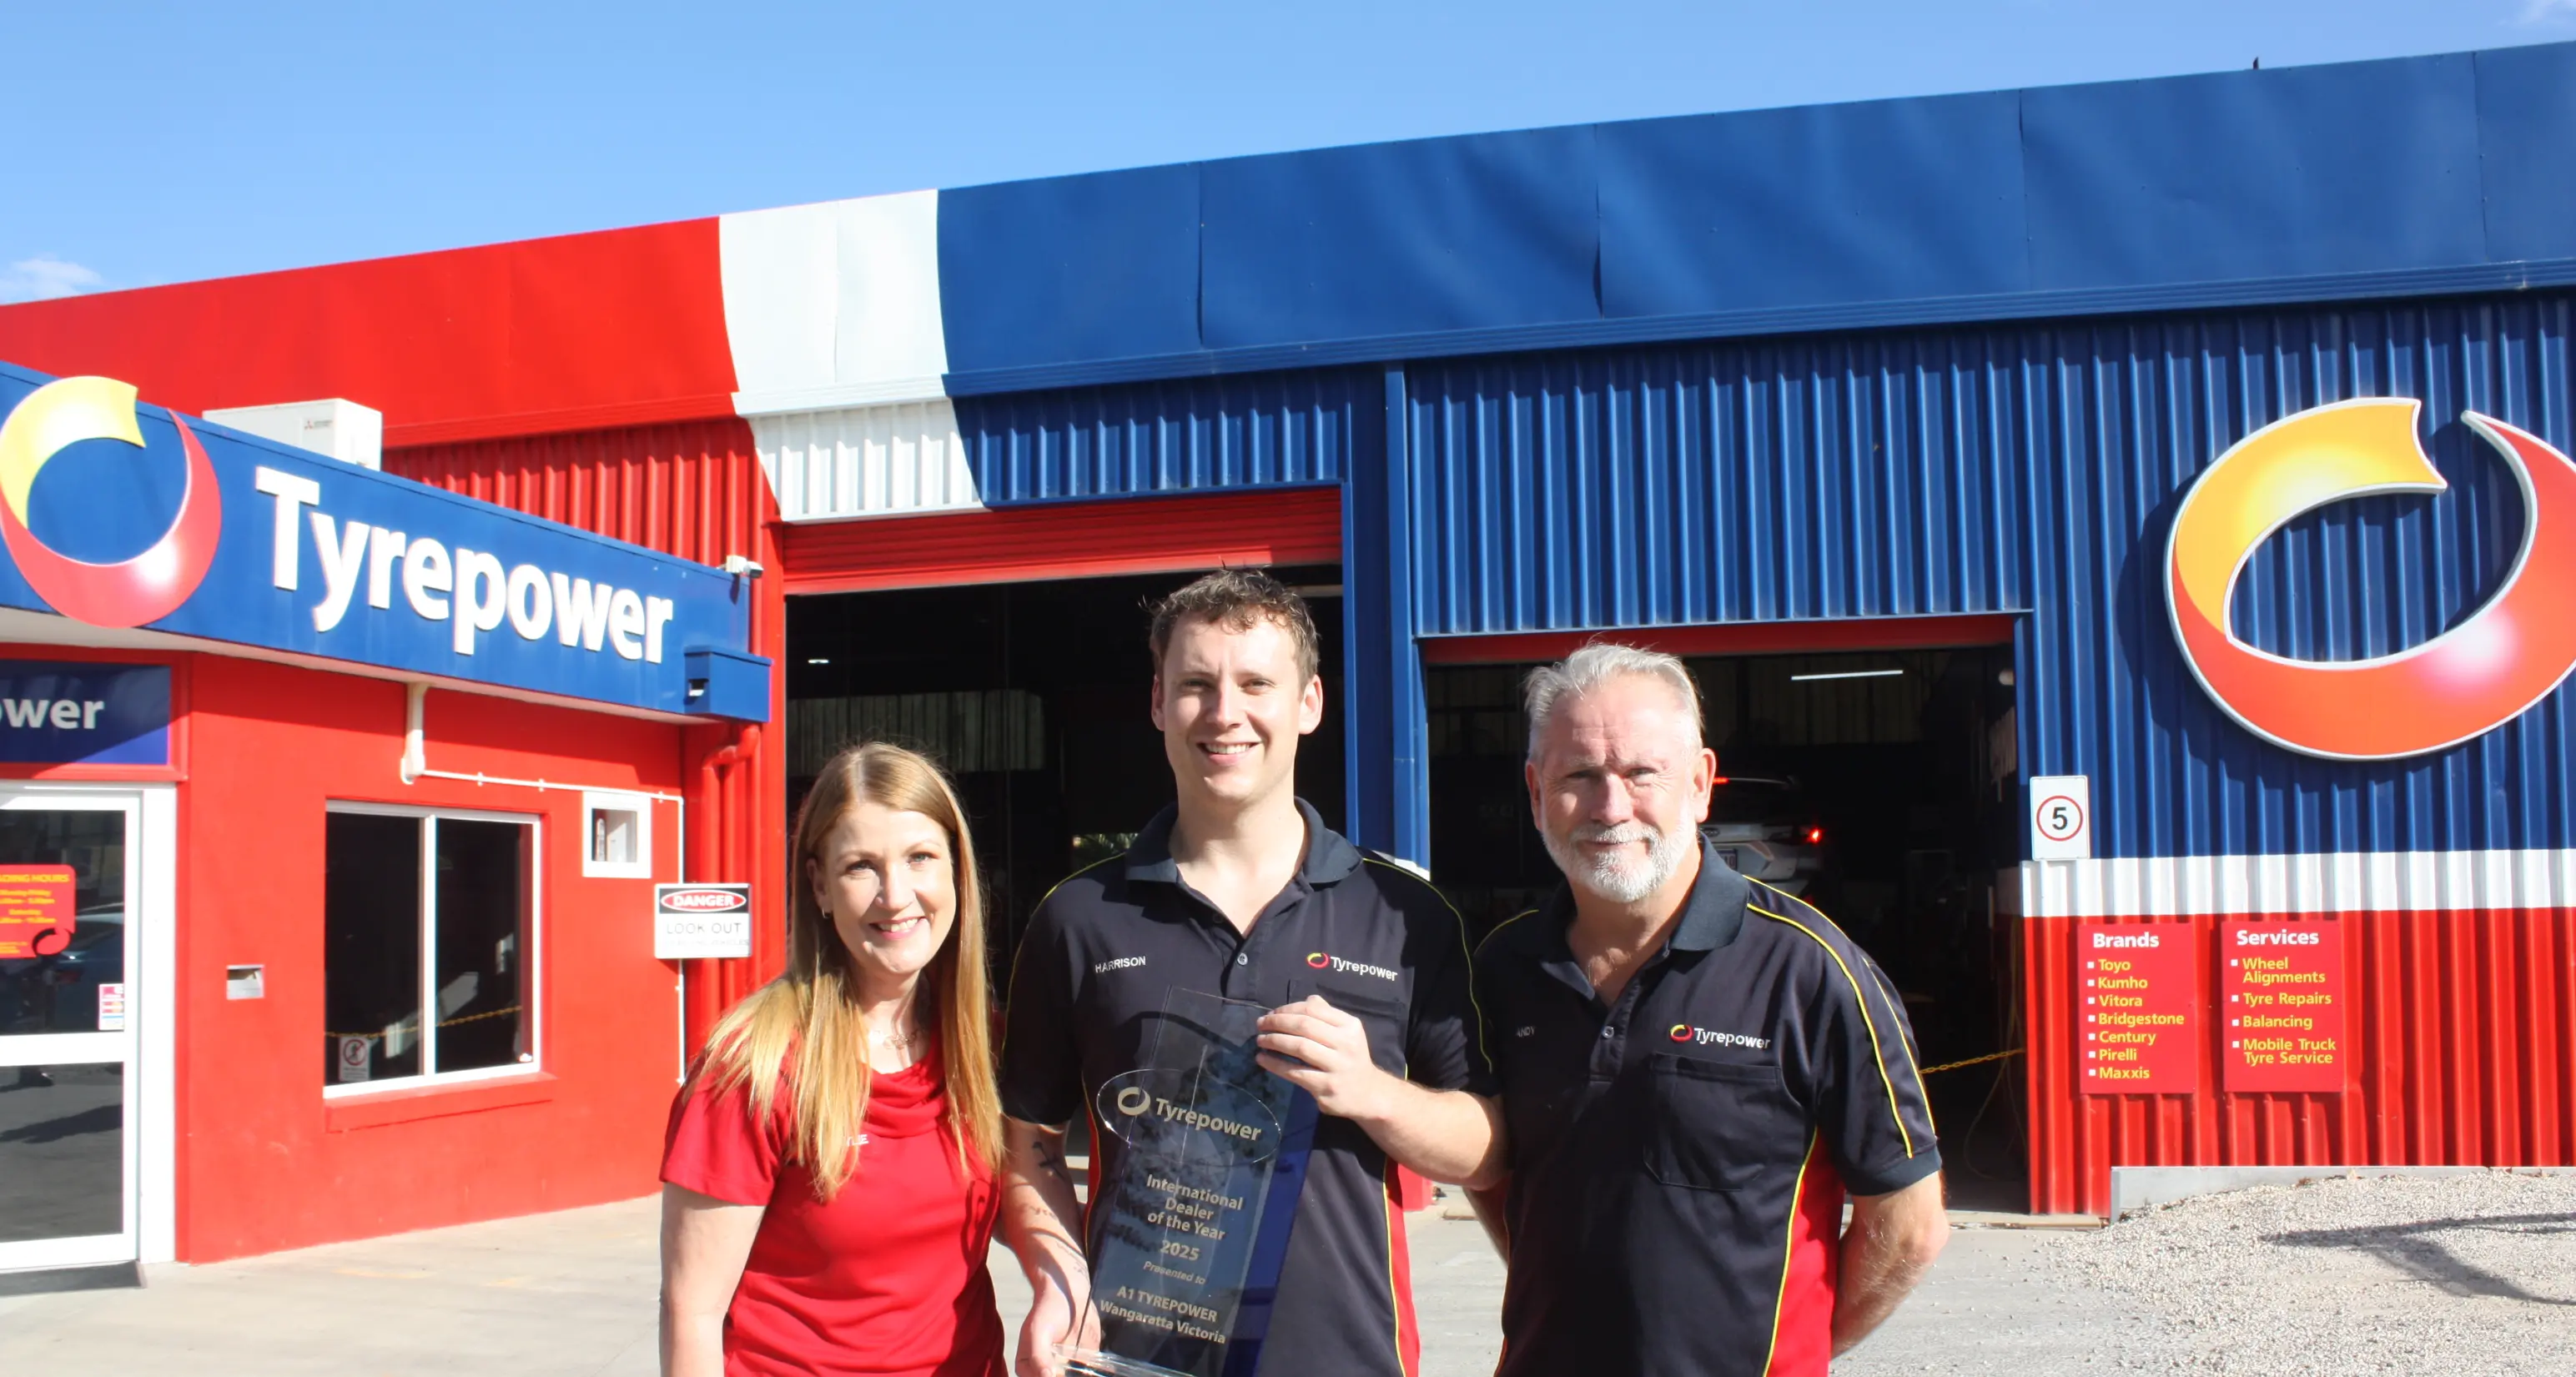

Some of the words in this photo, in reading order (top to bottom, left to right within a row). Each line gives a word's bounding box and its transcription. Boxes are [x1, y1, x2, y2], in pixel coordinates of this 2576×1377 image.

[255, 465, 673, 664] Tyrepower
[0, 699, 104, 729] wer
[2052, 807, 2068, 831] 5
[673, 895, 734, 907] DANGER
[667, 922, 706, 934] LOOK
[712, 922, 742, 934] OUT
[2093, 932, 2160, 948] Brands
[2236, 929, 2320, 946] Services
[1094, 955, 1146, 973] HARRISON
[1331, 956, 1398, 982] Tyrepower
[2098, 959, 2131, 974] Toyo
[2242, 957, 2289, 970] Wheel
[2098, 976, 2148, 989] Kumho
[2242, 971, 2326, 984] Alignments
[2099, 994, 2143, 1007] Vitora
[2243, 993, 2273, 1008] Tyre
[2278, 993, 2332, 1007] Repairs
[2098, 1012, 2185, 1028] Bridgestone
[2242, 1015, 2313, 1031] Balancing
[1516, 1026, 1536, 1038] ANDY
[1694, 1028, 1771, 1050] Tyrepower
[2099, 1030, 2156, 1046] Century
[2243, 1038, 2293, 1051] Mobile
[2297, 1038, 2337, 1051] Truck
[2099, 1048, 2137, 1061] Pirelli
[2244, 1052, 2275, 1067] Tyre
[2280, 1051, 2333, 1064] Service
[2099, 1067, 2151, 1079] Maxxis
[1155, 1098, 1262, 1141] Tyrepower
[1146, 1174, 1244, 1210] International
[1165, 1198, 1215, 1220] Dealer
[1147, 1212, 1165, 1224] of
[1166, 1214, 1190, 1231] the
[1194, 1221, 1226, 1240] Year
[1160, 1239, 1200, 1260] 2025
[1143, 1260, 1195, 1281] Presented
[1195, 1274, 1205, 1284] to
[1116, 1285, 1135, 1300] A1
[1137, 1290, 1218, 1323] TYREPOWER
[1099, 1299, 1174, 1329] Wangaratta
[1177, 1319, 1226, 1344] Victoria
